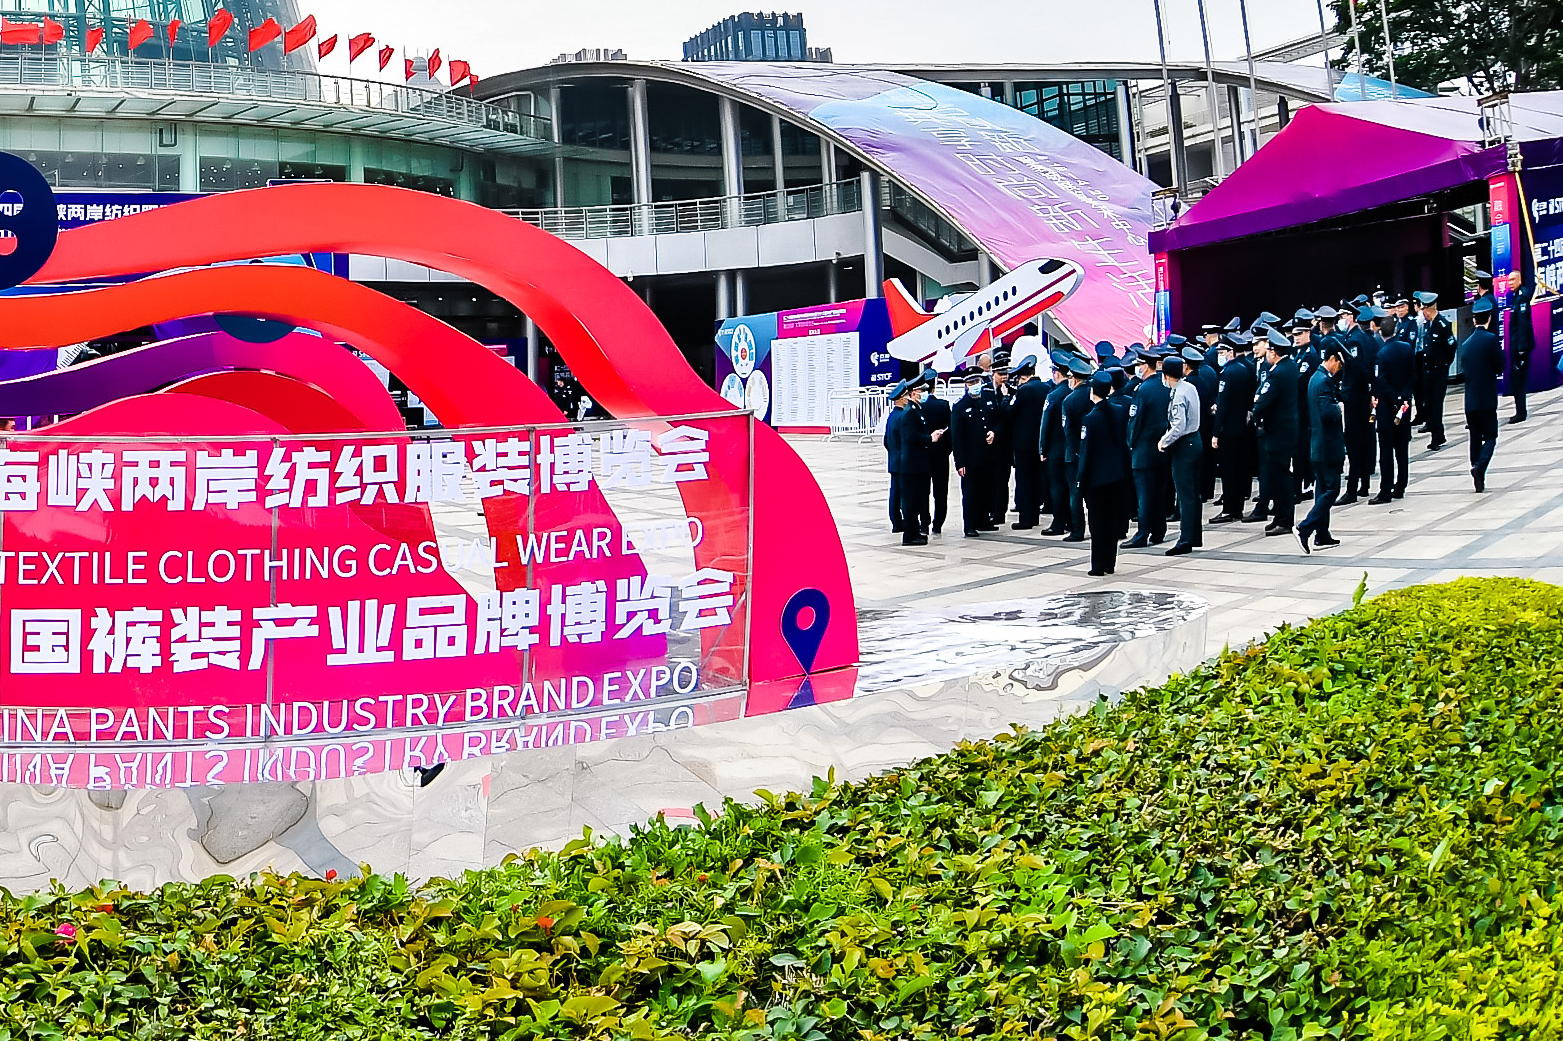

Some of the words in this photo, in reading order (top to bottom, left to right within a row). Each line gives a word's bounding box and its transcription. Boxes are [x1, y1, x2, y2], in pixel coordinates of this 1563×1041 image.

[158, 544, 358, 585] CLOTHING
[368, 534, 509, 576] CASUAL
[516, 526, 613, 565] WEAR
[621, 516, 704, 555] EXPO
[90, 704, 230, 742] PANTS
[245, 694, 457, 738] INDUSTRY
[464, 675, 595, 723] BRAND
[603, 660, 699, 706] EXPO
